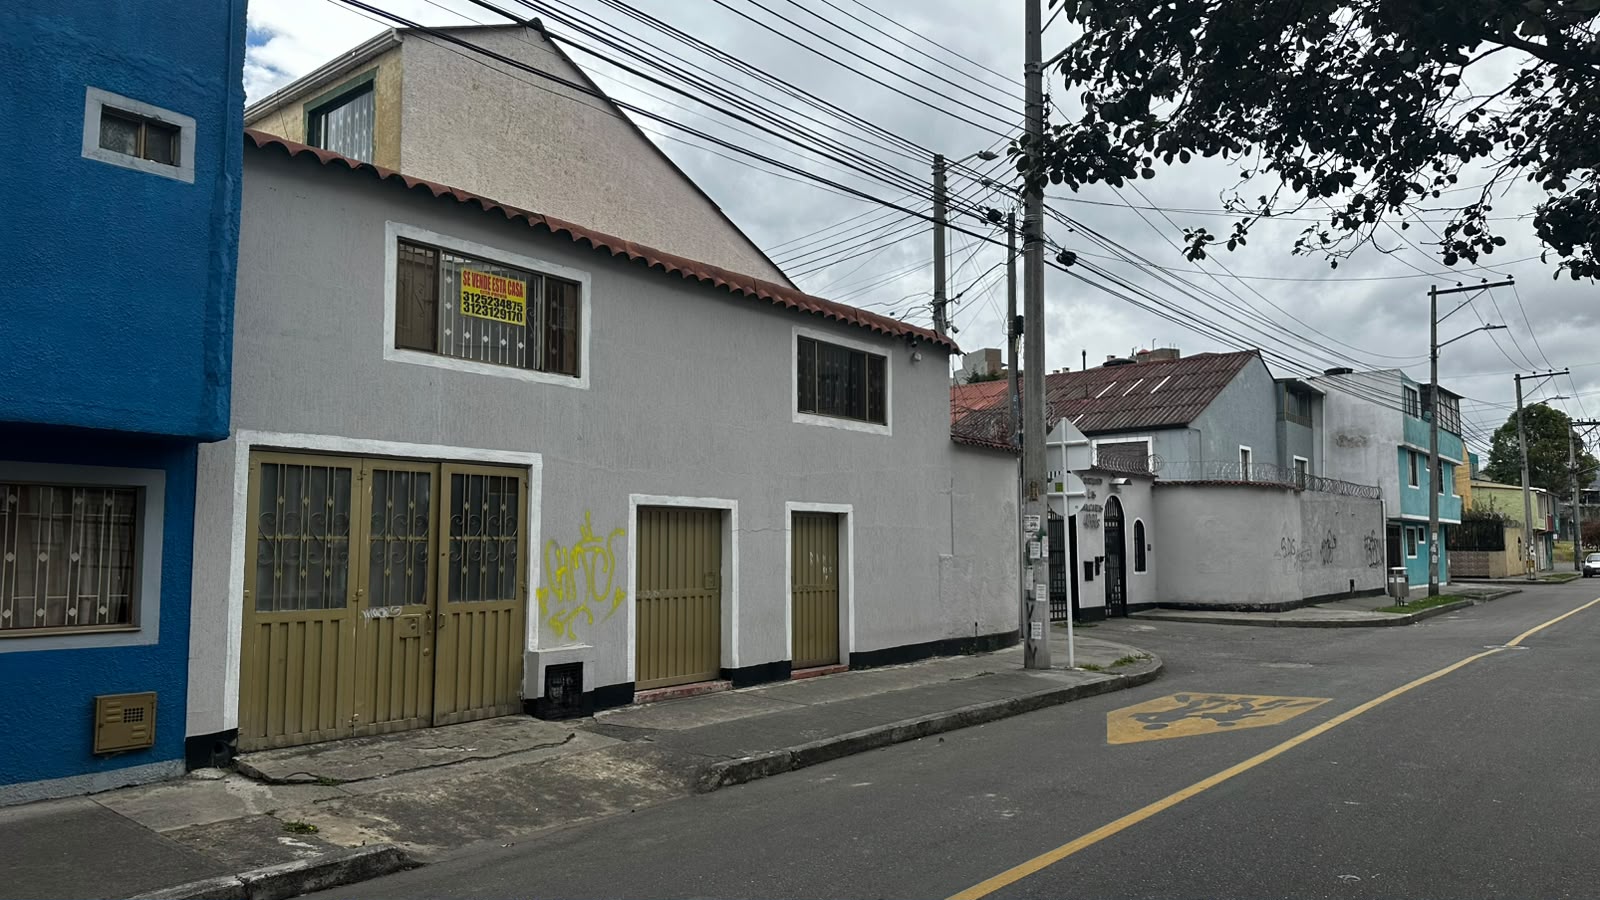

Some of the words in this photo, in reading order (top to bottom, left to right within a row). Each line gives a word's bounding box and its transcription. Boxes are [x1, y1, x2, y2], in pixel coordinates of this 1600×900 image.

[463, 270, 471, 287] SE
[471, 271, 491, 291] VENDE
[491, 277, 507, 294] ESTA
[507, 280, 523, 298] CASA
[463, 291, 523, 312] 3125234875
[463, 301, 523, 322] 3123129170
